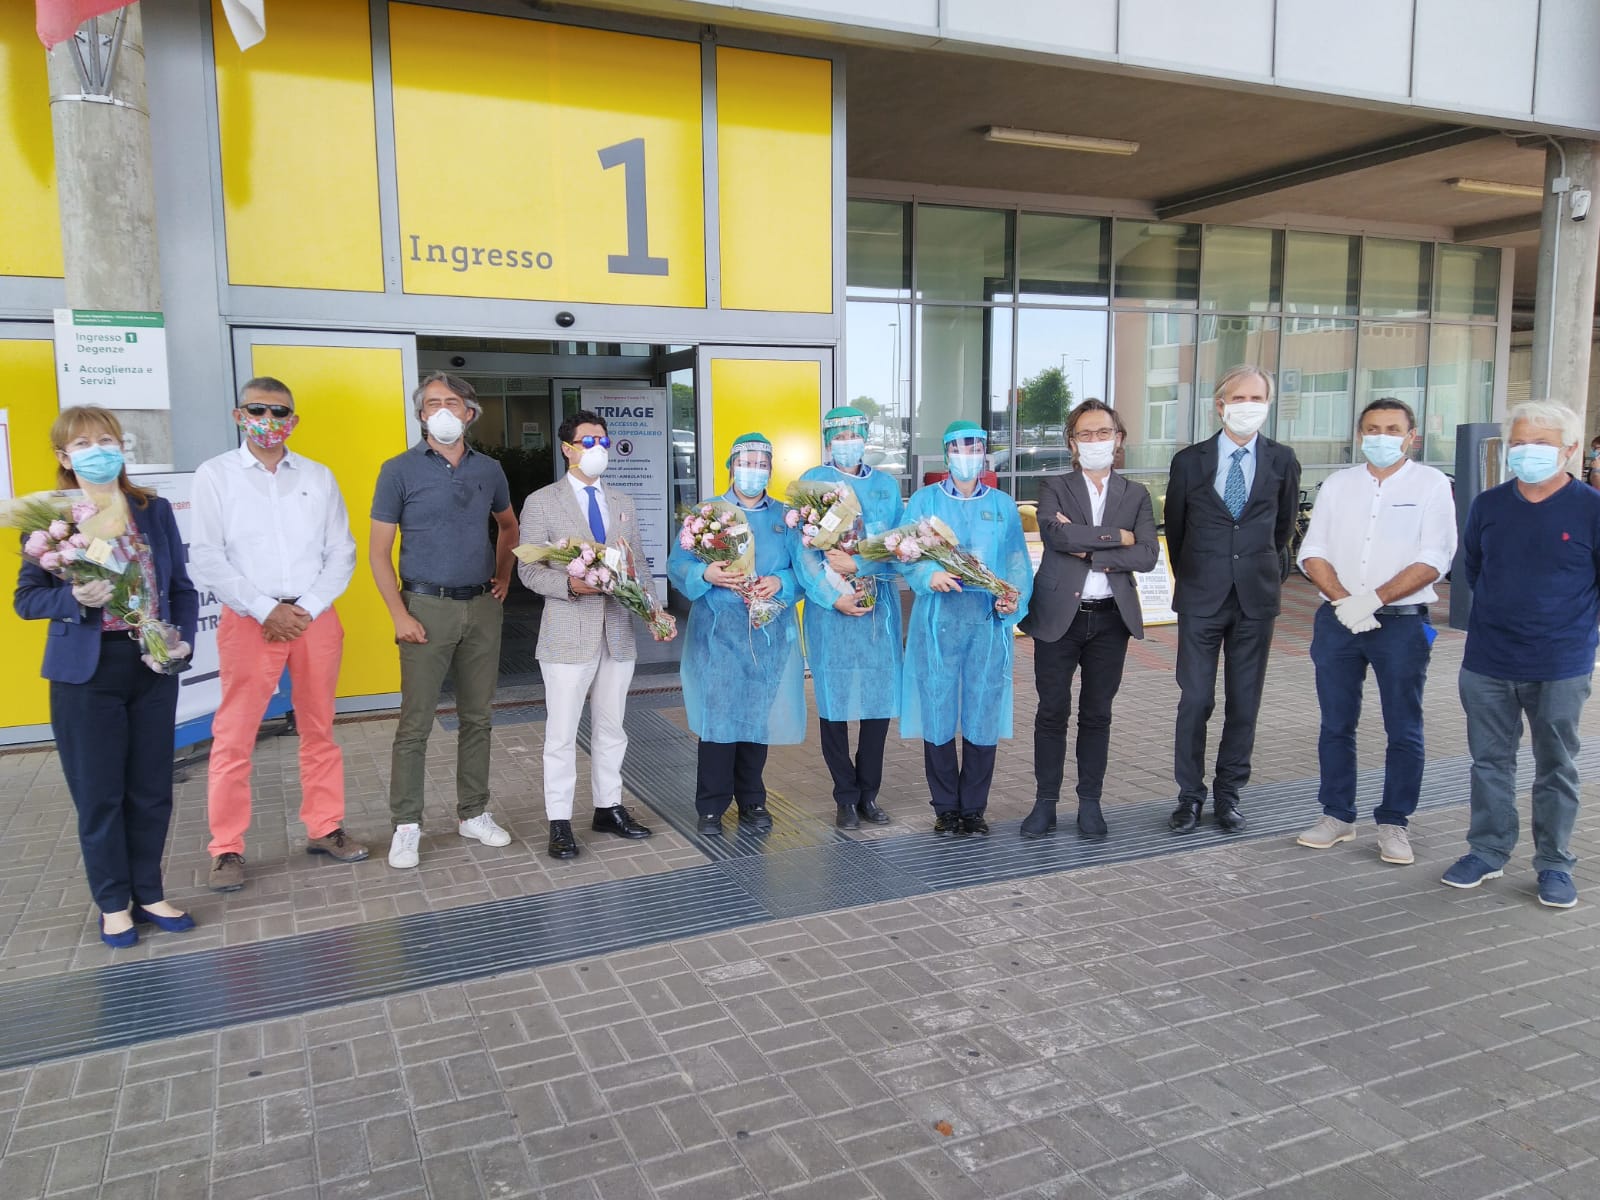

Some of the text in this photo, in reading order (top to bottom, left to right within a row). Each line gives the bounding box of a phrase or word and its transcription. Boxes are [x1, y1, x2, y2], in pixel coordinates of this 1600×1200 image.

[597, 138, 670, 276] 1
[409, 234, 553, 273] Ingresso
[76, 333, 122, 343] Ingresso
[77, 344, 125, 354] Degenze
[79, 365, 143, 375] Accoglienza
[79, 376, 116, 385] Servizi
[595, 407, 654, 418] TRIAGE
